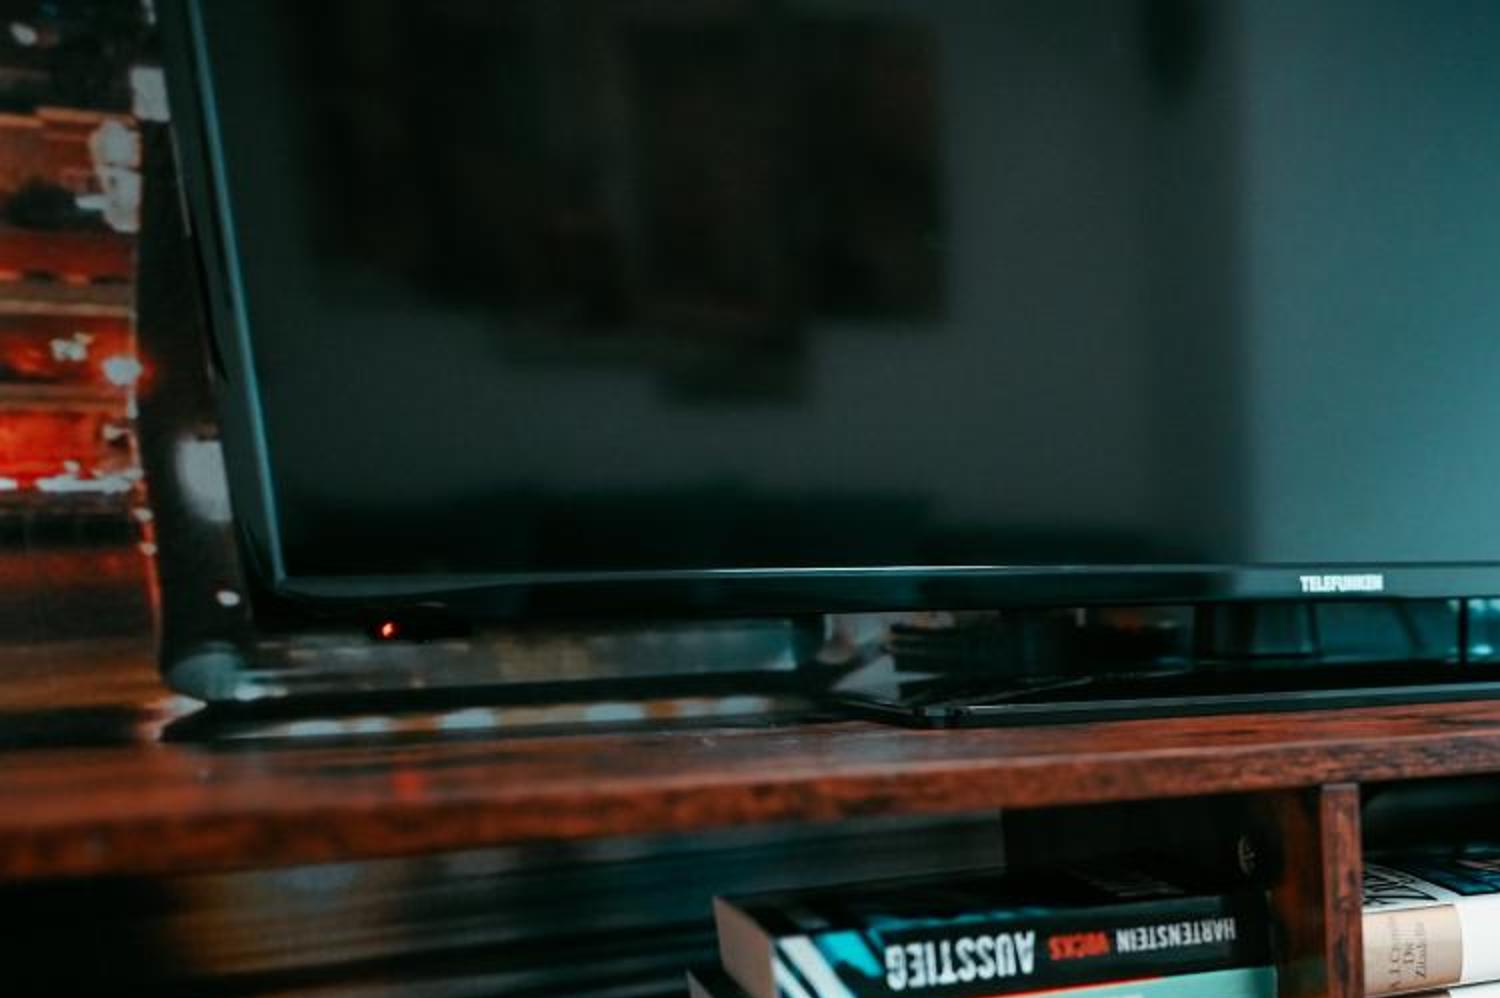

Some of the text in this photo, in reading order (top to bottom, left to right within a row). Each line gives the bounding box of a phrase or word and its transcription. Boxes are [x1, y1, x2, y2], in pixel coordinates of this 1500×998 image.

[1299, 574, 1384, 592] TELEFUNKEN
[1116, 917, 1237, 953] HARTENSTEIN
[885, 930, 1036, 992] AUSSTIEG
